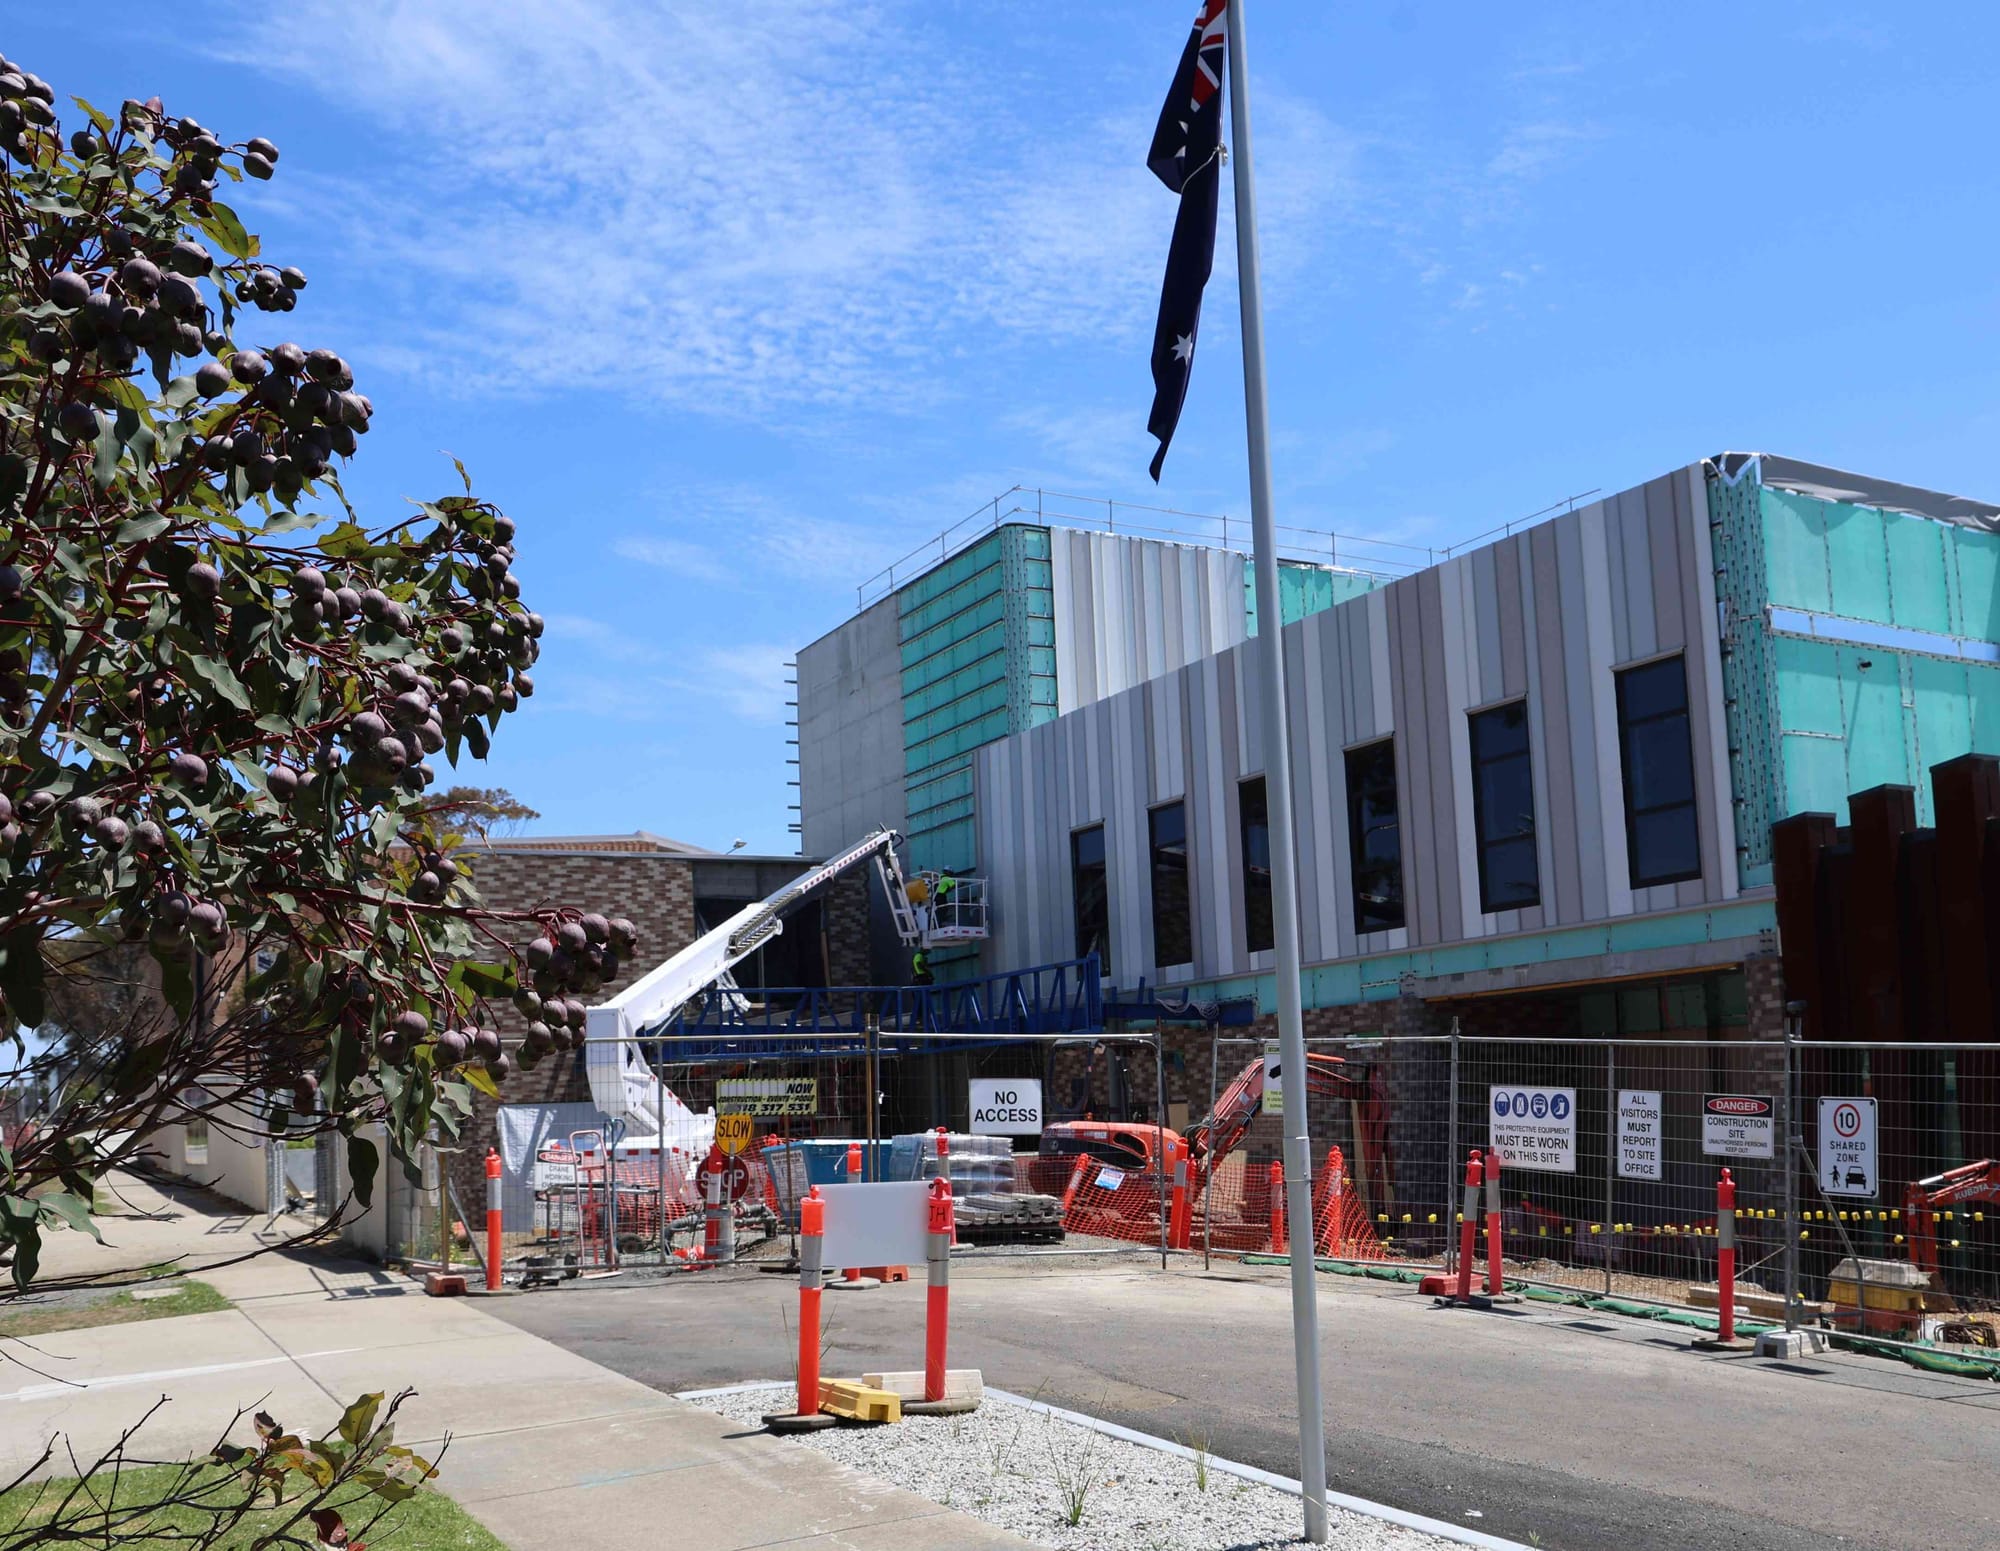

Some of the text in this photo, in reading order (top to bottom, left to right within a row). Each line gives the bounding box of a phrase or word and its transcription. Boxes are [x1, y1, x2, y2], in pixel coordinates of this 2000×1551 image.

[786, 1083, 814, 1094] NOW
[995, 1091, 1017, 1105] NO
[1631, 1095, 1647, 1105] ALL
[761, 1104, 784, 1112] 317
[1715, 1100, 1758, 1111] DANGER
[974, 1108, 1038, 1122] ACCESS
[1620, 1108, 1658, 1120] VISITORS
[1707, 1116, 1768, 1128] CONSTRUCTION
[1839, 1112, 1855, 1129] 10
[718, 1120, 750, 1138] SLOW
[1505, 1125, 1537, 1133] PROTECTIVE
[1538, 1127, 1570, 1135] EQUIPMENT
[1627, 1122, 1652, 1133] MUST
[1728, 1129, 1745, 1139] SITE
[1495, 1134, 1568, 1150] MUST BE WORN
[1622, 1135, 1656, 1147] REPORT
[1829, 1140, 1866, 1151] SHARED
[1503, 1149, 1560, 1164] ON THIS SITE
[1624, 1148, 1655, 1161] TO SITE
[1836, 1153, 1860, 1163] ZONE
[1624, 1162, 1655, 1174] OFFICE
[701, 1168, 745, 1189] SOP
[1955, 1183, 1989, 1200] KUBOTA
